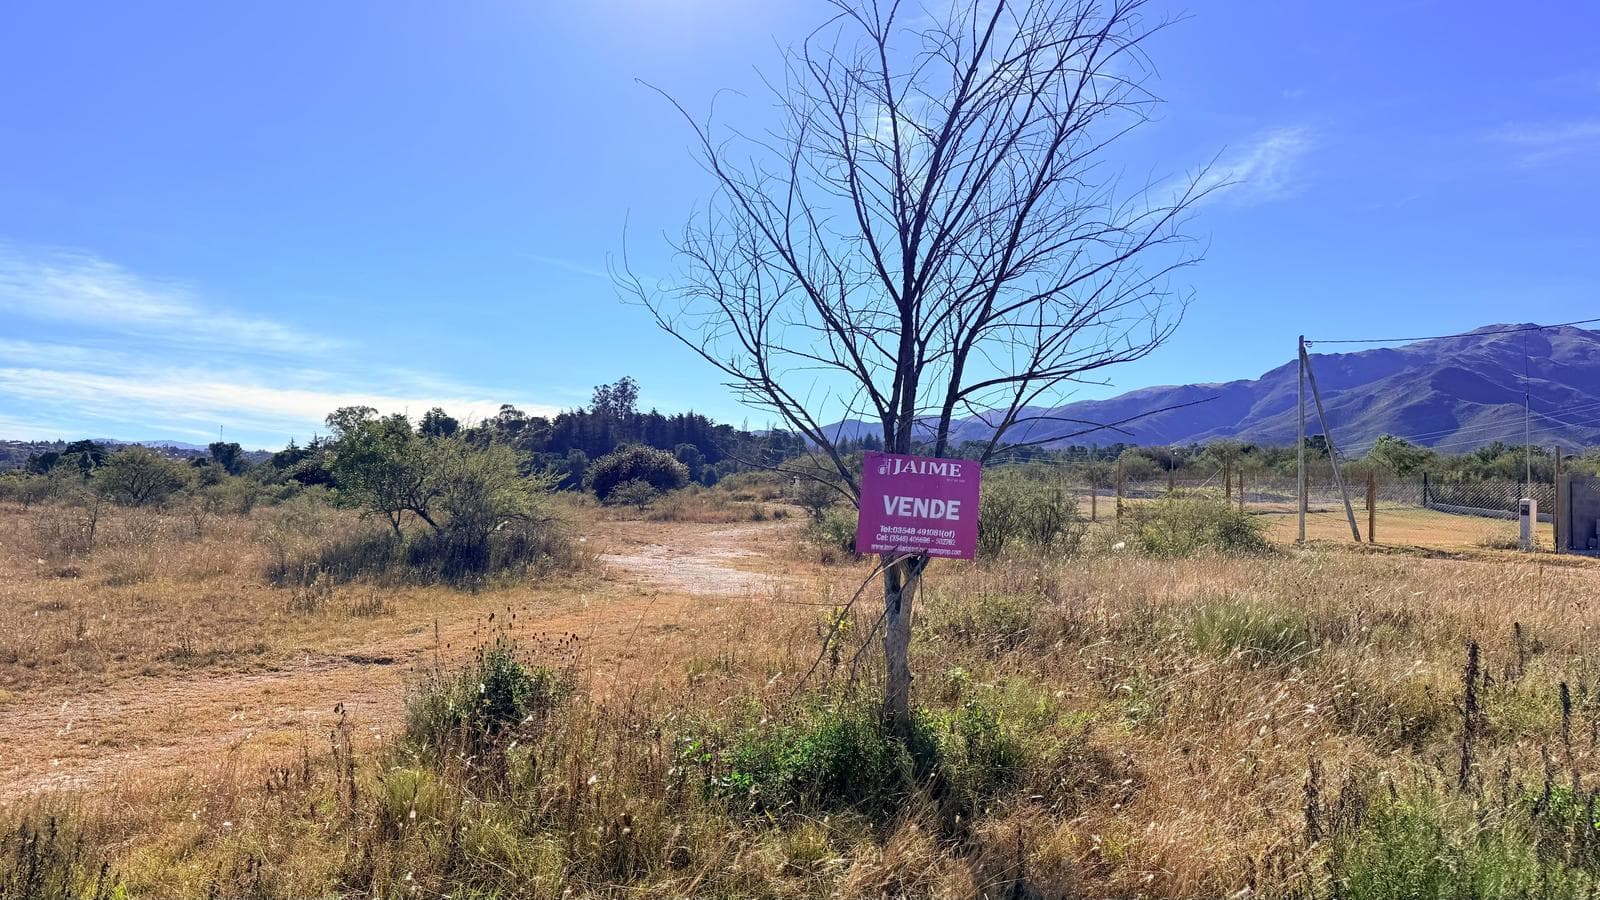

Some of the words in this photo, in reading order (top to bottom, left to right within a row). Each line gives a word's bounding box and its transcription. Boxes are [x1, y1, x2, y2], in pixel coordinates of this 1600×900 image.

[893, 459, 962, 477] JAIME
[883, 495, 960, 521] VENDE
[880, 525, 916, 535] Tel:03548
